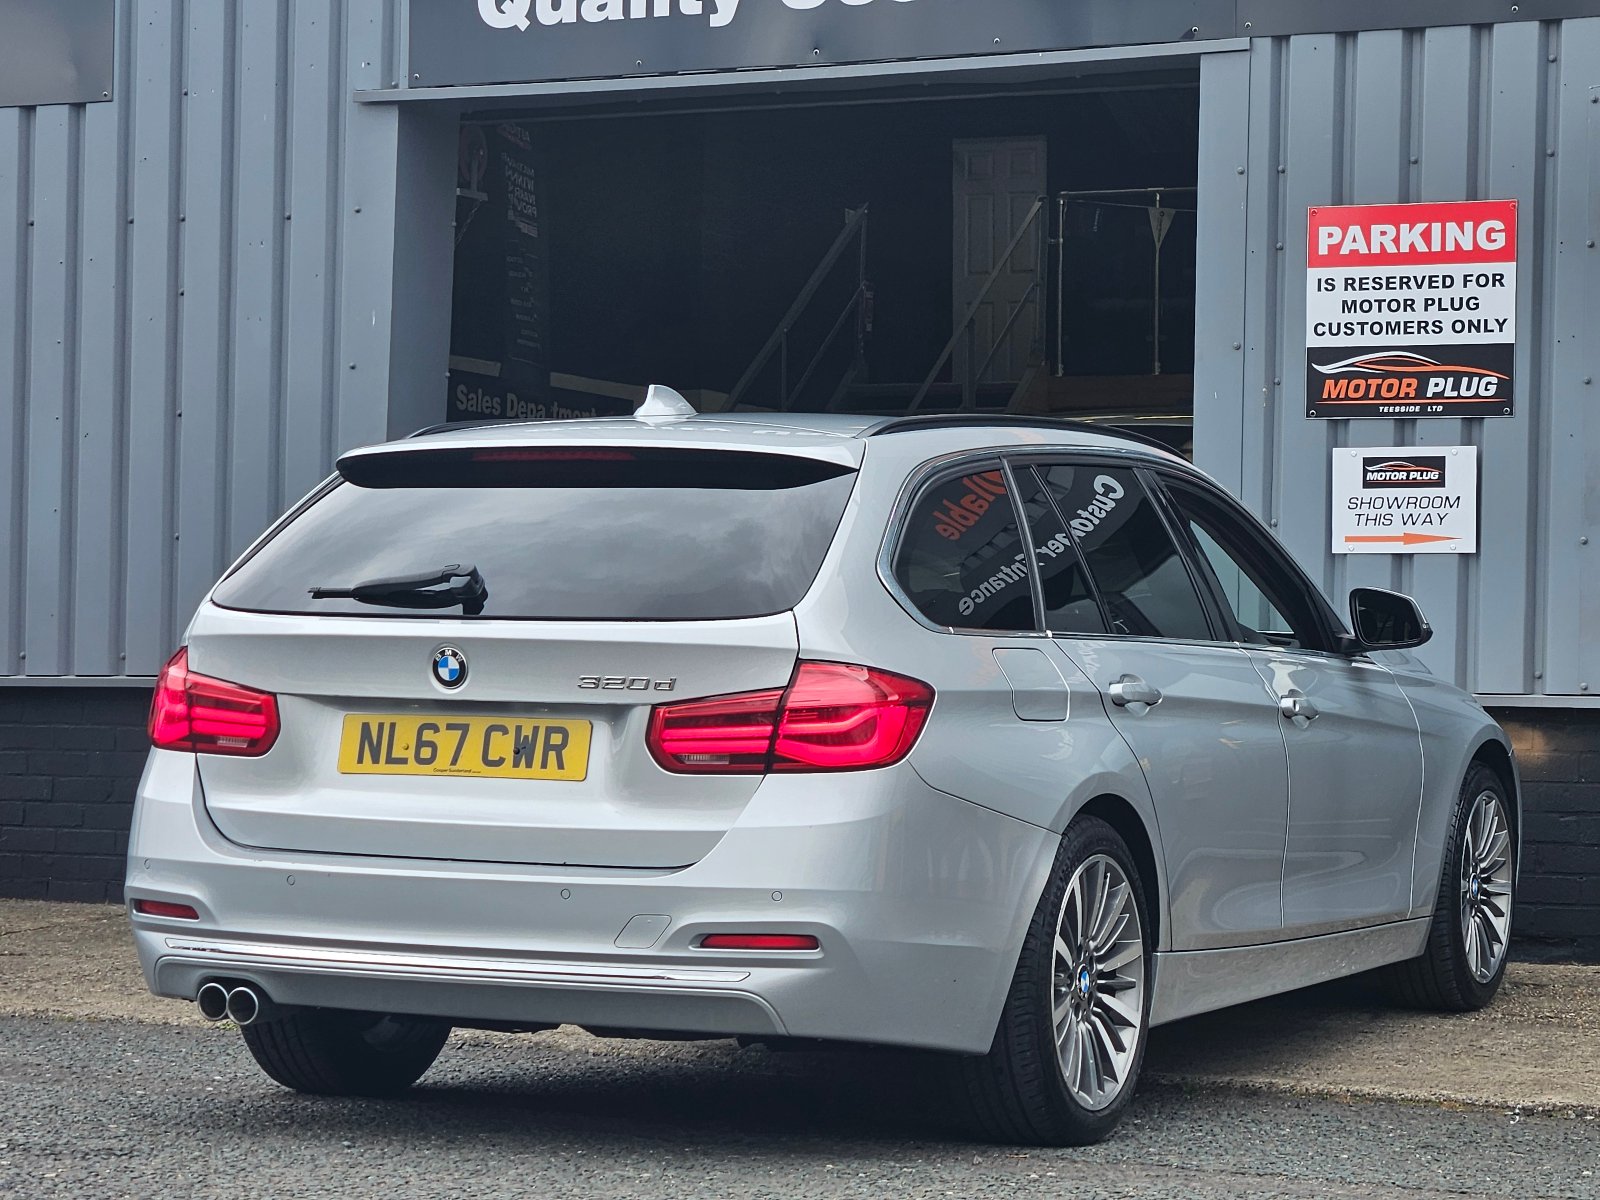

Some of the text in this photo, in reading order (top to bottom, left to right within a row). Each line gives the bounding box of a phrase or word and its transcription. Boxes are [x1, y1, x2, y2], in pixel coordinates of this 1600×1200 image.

[1318, 220, 1506, 256] PARKING
[1317, 273, 1505, 292] IS RESERVED FOR
[1341, 296, 1480, 314] MOTOR PLUG
[1313, 318, 1508, 337] CUSTOMERS ONLY
[1322, 376, 1498, 399] MOTOR PLUG
[455, 384, 501, 416] Sales
[1378, 405, 1421, 413] TEESSIDE
[1366, 471, 1439, 481] MOTOR PLUG
[1347, 496, 1461, 510] SHOWROOM
[1354, 512, 1449, 527] THIS WAY
[577, 675, 677, 691] 320d
[356, 721, 570, 770] NL67 CWR
